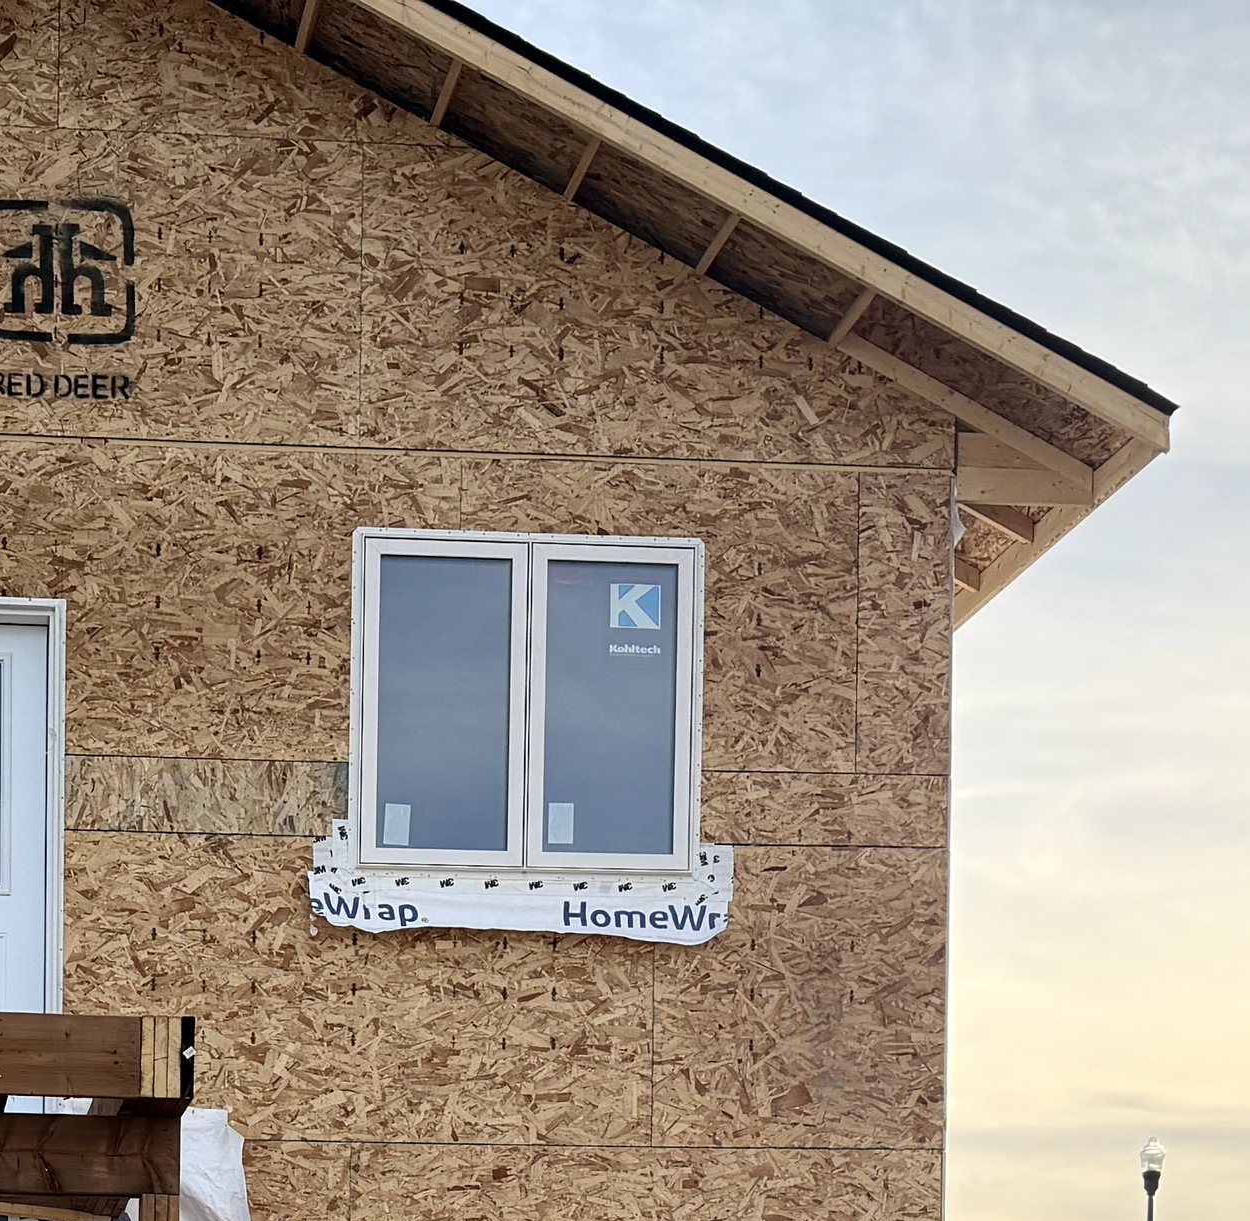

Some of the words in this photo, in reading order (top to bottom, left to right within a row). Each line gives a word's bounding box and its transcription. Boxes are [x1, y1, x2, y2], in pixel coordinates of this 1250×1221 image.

[53, 374, 132, 399] DEER
[609, 644, 661, 654] Kohltech
[351, 877, 366, 887] 3M
[395, 877, 410, 887] 3M
[440, 878, 455, 888] 3M
[484, 879, 499, 889] 3M
[529, 881, 544, 891] 3M
[573, 882, 588, 891] 3M
[618, 882, 633, 893] 3M
[662, 882, 677, 892] 3M
